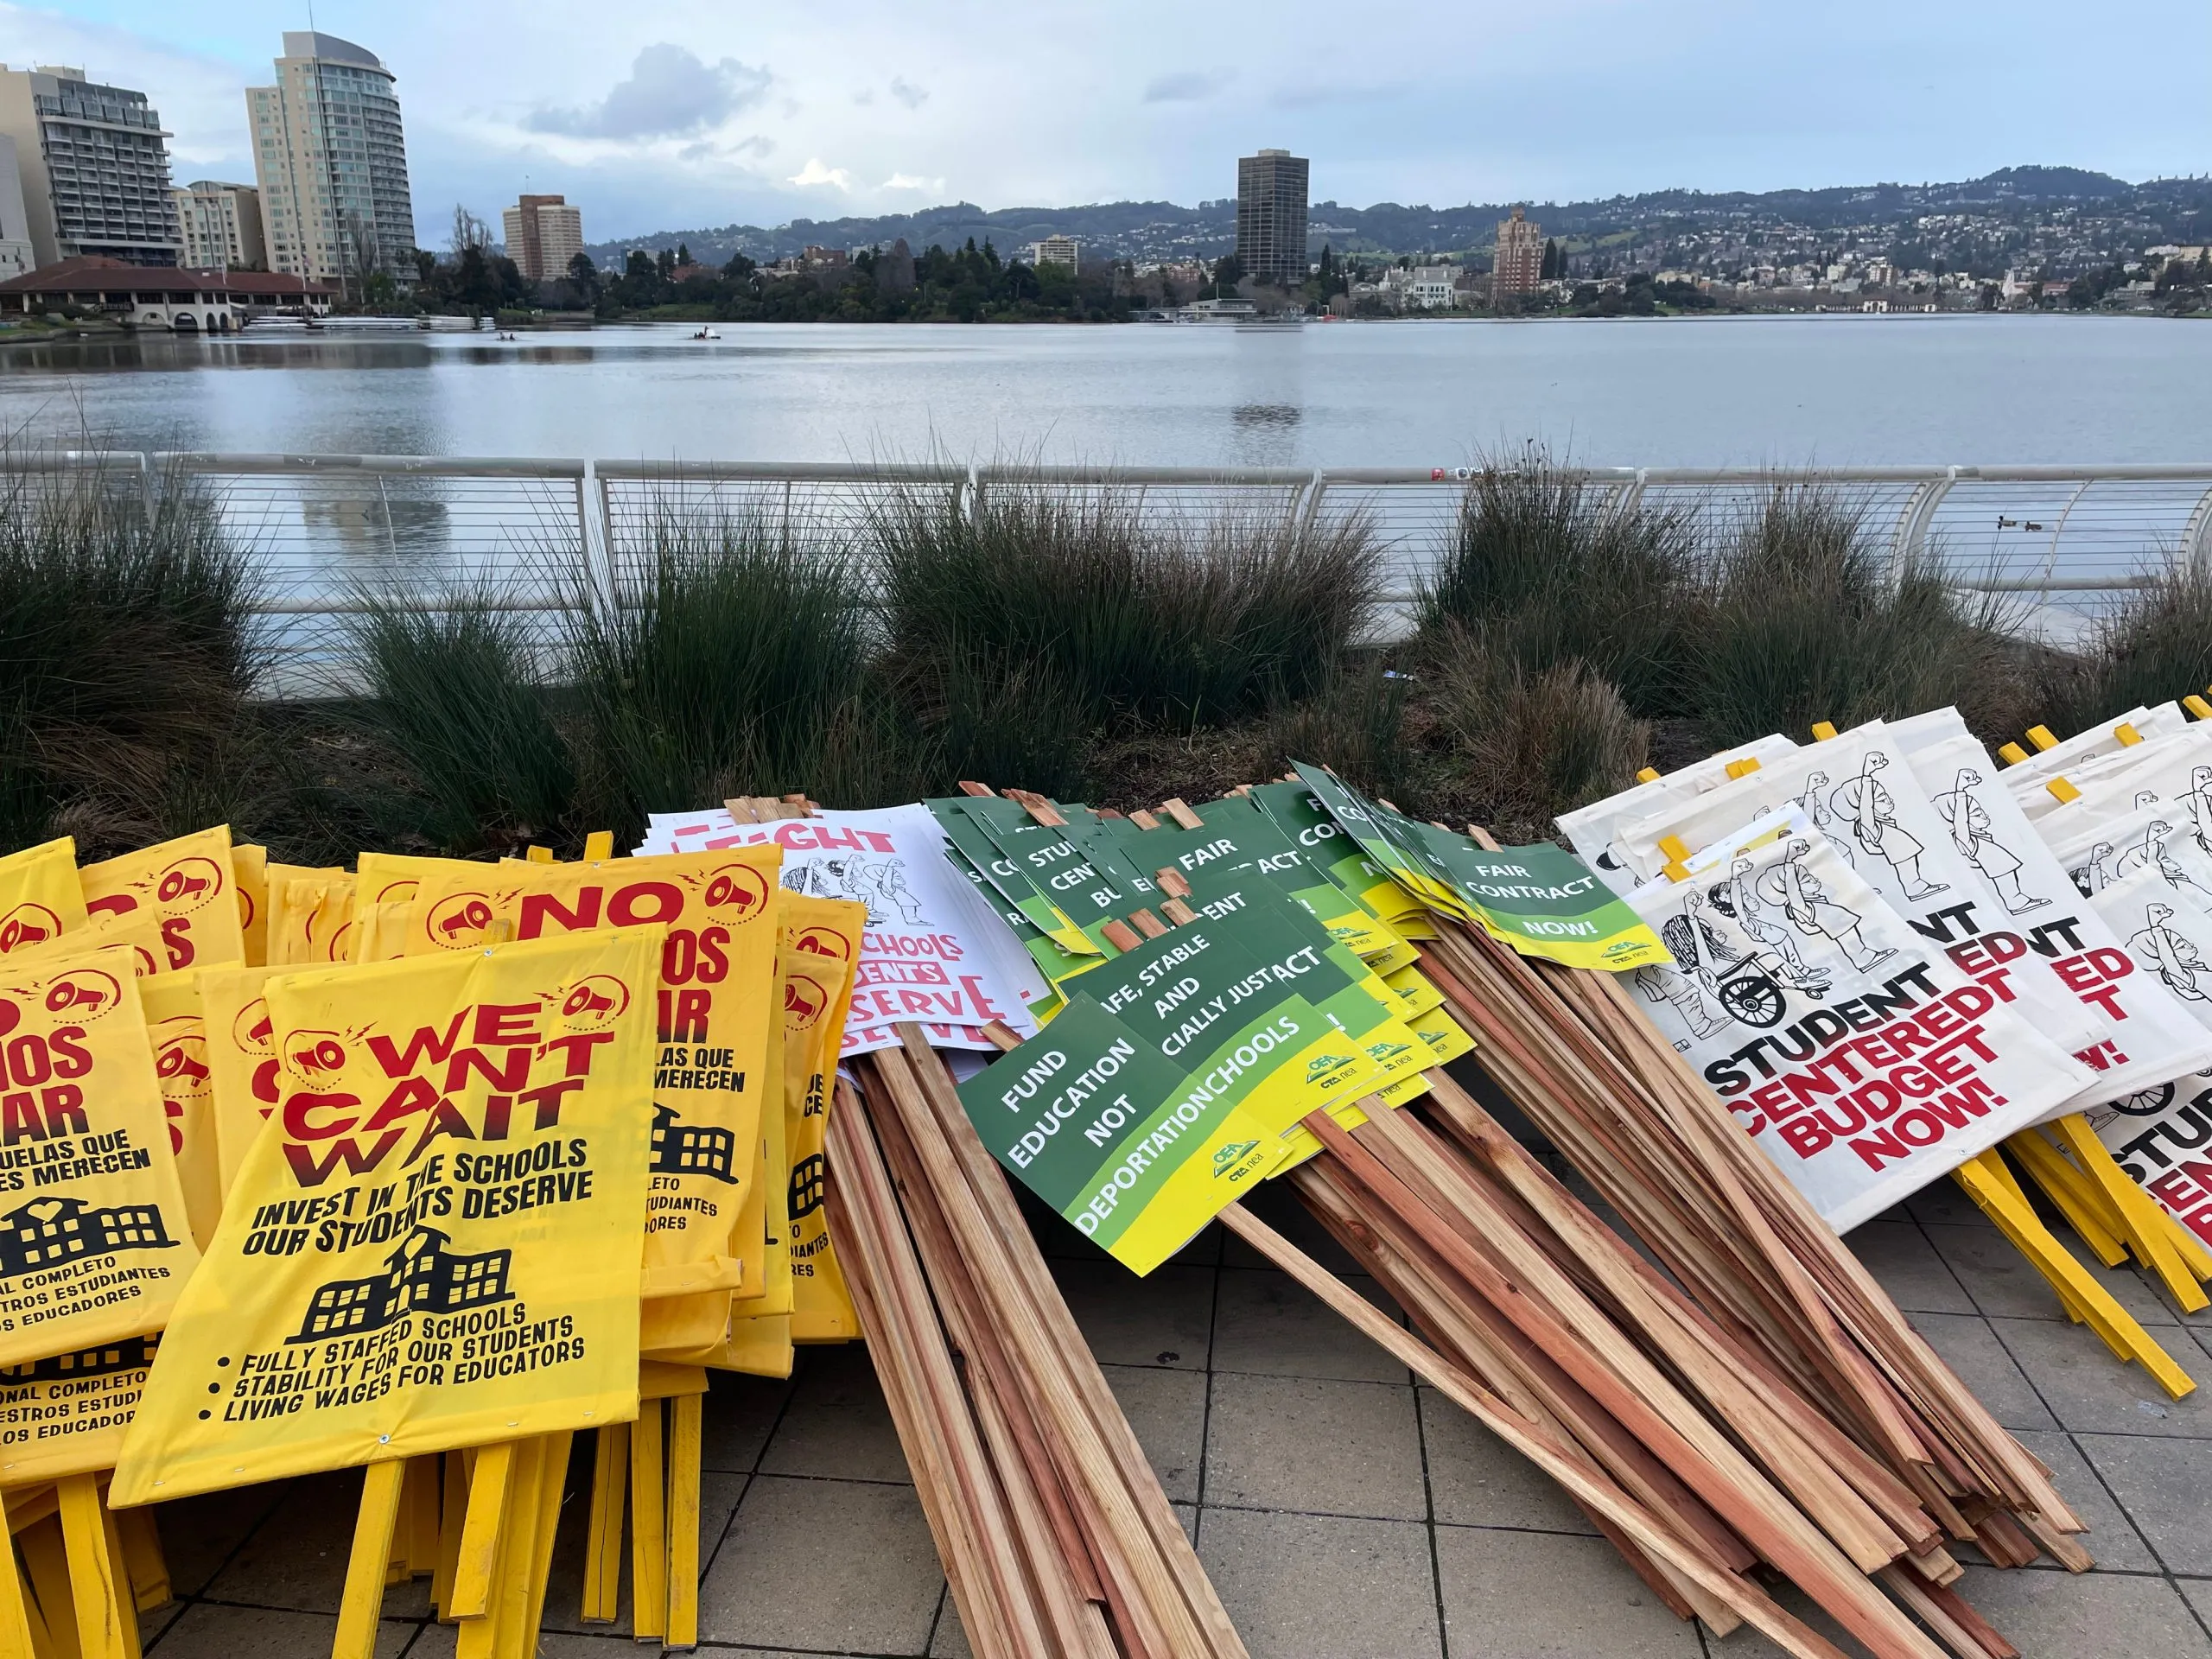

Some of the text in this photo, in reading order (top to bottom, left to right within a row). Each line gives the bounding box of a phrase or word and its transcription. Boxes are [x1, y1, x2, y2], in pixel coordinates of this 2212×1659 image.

[1178, 838, 1239, 872] FAIR
[1475, 864, 1533, 878] FAIR
[1465, 875, 1595, 899] CONTRACT
[518, 881, 684, 940] NO
[1522, 920, 1599, 937] NOW!
[1138, 933, 1211, 988] STABLE
[1606, 941, 1637, 951] OEA
[856, 961, 943, 983] ENTS
[1226, 967, 1274, 1006] JUST
[845, 976, 1007, 1023] SERVE
[1153, 976, 1201, 1020] AND
[365, 1001, 543, 1079] WE
[1705, 961, 1942, 1096] STUDENT
[694, 1047, 734, 1069] QUE
[1308, 1053, 1340, 1071] OEA
[1340, 1067, 1357, 1081] nea
[1726, 986, 1994, 1138] CENTERED
[283, 1031, 614, 1141] CAN'T
[654, 1069, 746, 1093] MERECEN
[1001, 1050, 1068, 1114] FUND
[1777, 1025, 1999, 1160] BUDGET
[1007, 1037, 1137, 1170] EDUCATION
[1084, 1092, 1137, 1148] NOT
[1847, 1076, 2010, 1173] NOW!
[82, 1128, 131, 1156] QUE
[282, 1078, 585, 1188] WAIT
[1213, 1142, 1243, 1164] OEA
[32, 1148, 151, 1186] MERECEN
[1074, 1084, 1216, 1237] DEPORTATION
[1246, 1153, 1264, 1169] nea
[251, 1186, 360, 1230] INVEST
[369, 1182, 397, 1212] IN
[454, 1137, 587, 1183] SCHOOLS
[243, 1170, 594, 1257] OUR STUDENTS DESERVE
[22, 1255, 116, 1290] COMPLETO
[54, 1267, 171, 1300] ESTUDIANTES
[22, 1285, 142, 1326] EDUCADORES
[232, 1314, 574, 1399] STABILITY FOR OUR STUDENTS
[239, 1302, 526, 1377] FULLY STAFFED SCHOOLS
[48, 1371, 147, 1400] COMPLETO
[223, 1336, 586, 1422] LIVING WAGES FOR EDUCATORS
